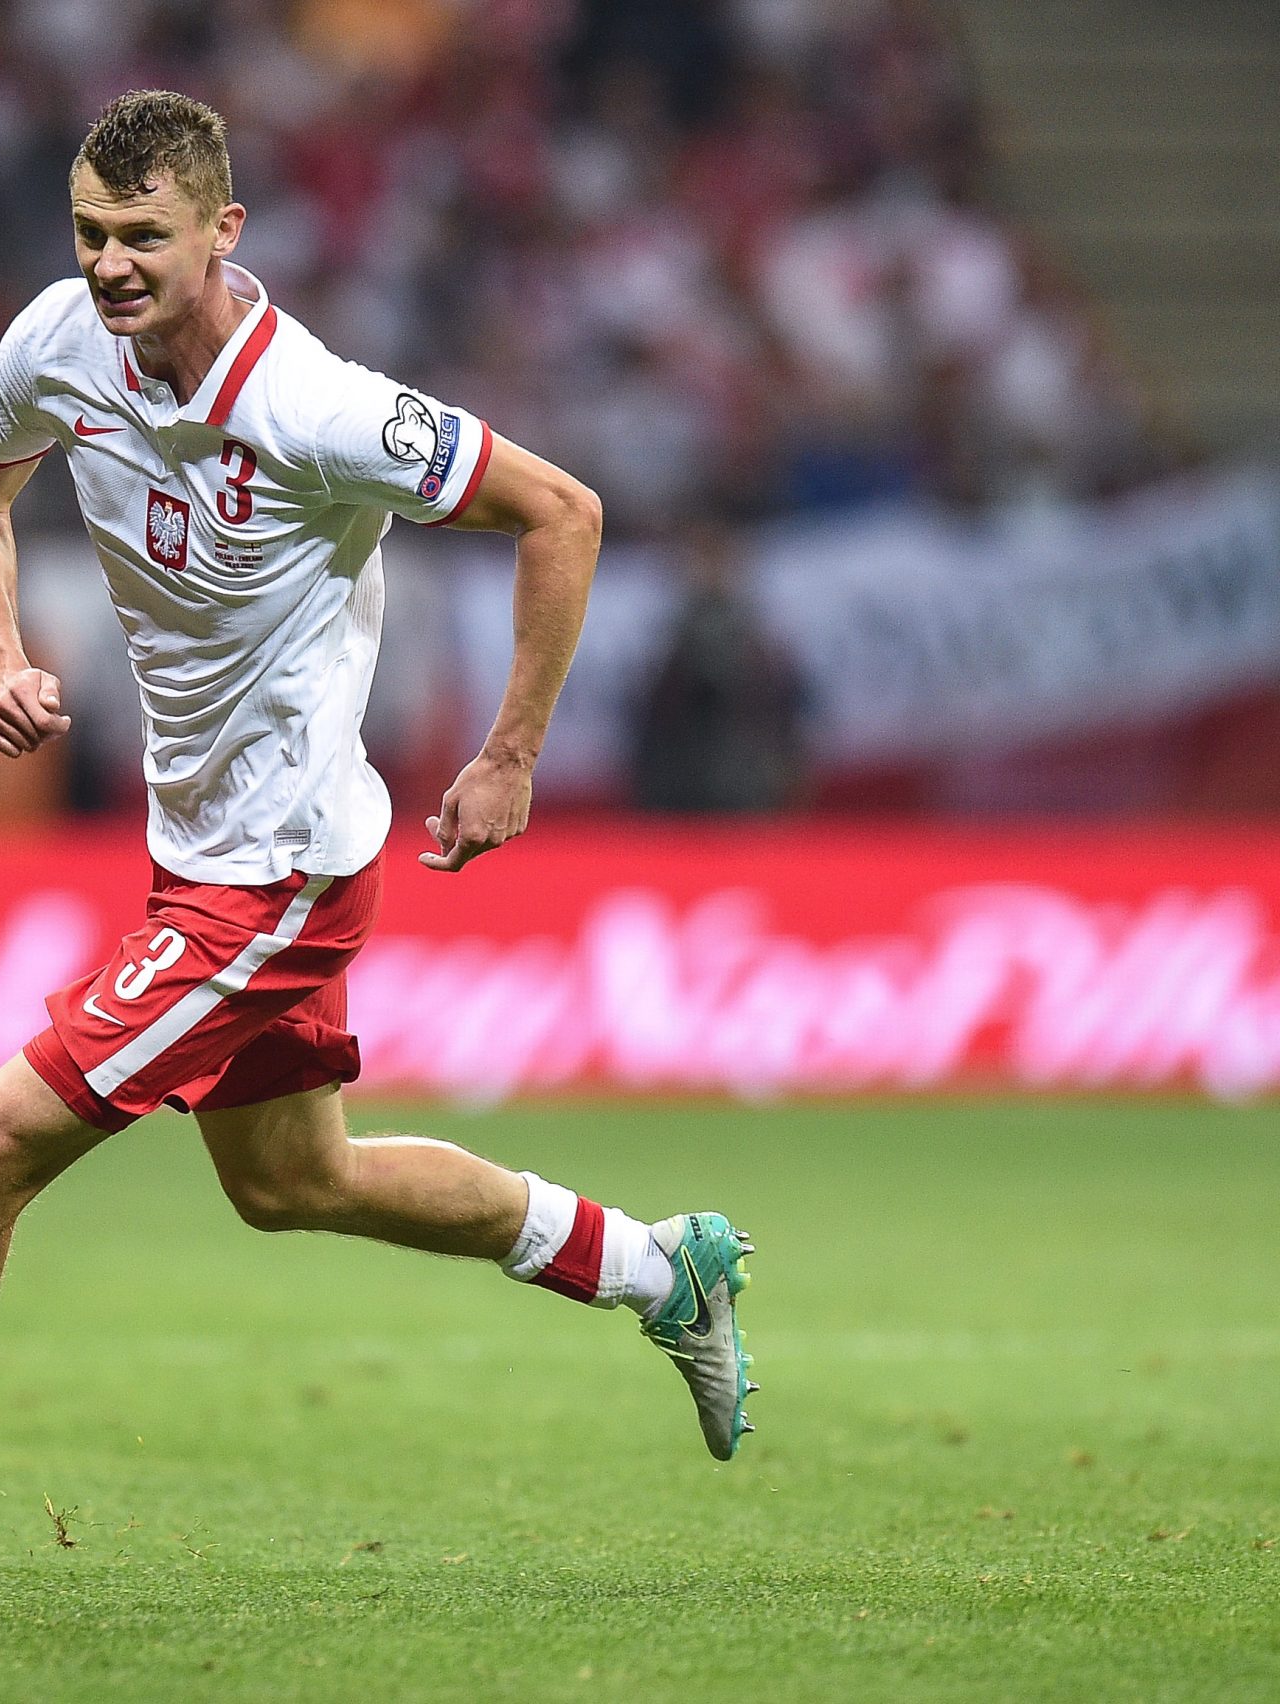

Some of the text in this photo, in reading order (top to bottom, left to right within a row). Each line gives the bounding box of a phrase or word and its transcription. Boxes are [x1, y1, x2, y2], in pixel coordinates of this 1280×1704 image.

[432, 412, 455, 476] RESPECT
[216, 439, 257, 525] 3
[114, 926, 187, 1001] 3
